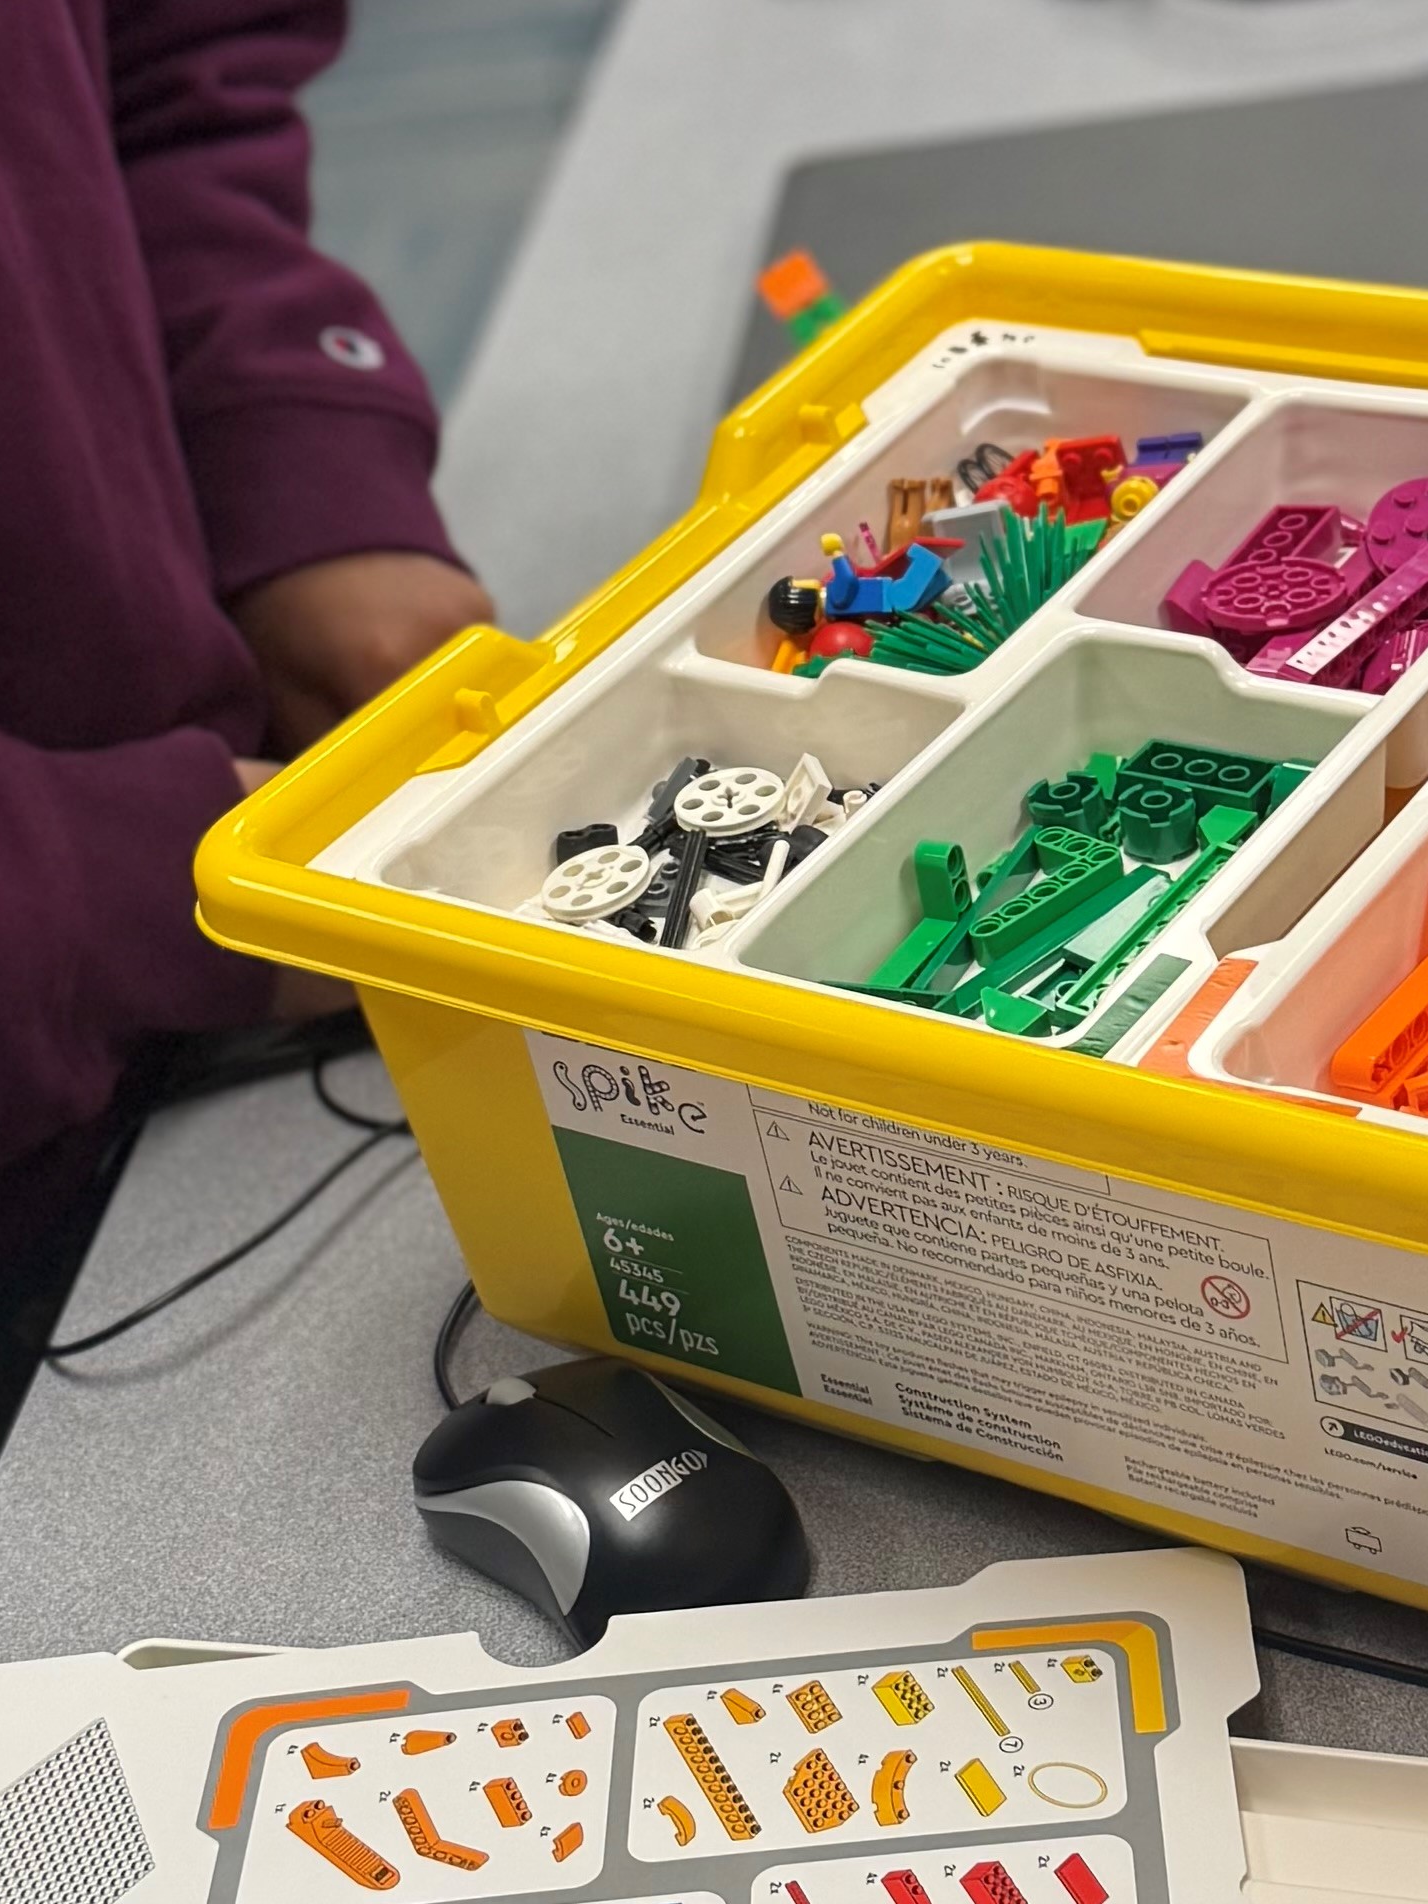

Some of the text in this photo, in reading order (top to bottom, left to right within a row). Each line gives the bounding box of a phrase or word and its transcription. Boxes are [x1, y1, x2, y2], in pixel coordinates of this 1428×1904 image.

[619, 1113, 674, 1135] Essential
[807, 1101, 1027, 1167] Not for children under 3 years.
[808, 1130, 1224, 1252] AVERTISSEMENT RISQUE D'ÉTOUFFEMENT.
[810, 1150, 1269, 1279] Le jouet contient des petites pièces ainsi qu'une petite boule.
[814, 1165, 1169, 1269] Il ne convient pas aux enfants de moins de 3 ans.
[595, 1211, 674, 1241] Ages/edades
[603, 1227, 644, 1255] 6+
[821, 1185, 1162, 1290] ADVERTENCIA: PELIGRO DE ASFIXIA.
[609, 1256, 663, 1282] 45345
[825, 1205, 1204, 1316] Juguete que contiene partes pequeñas y una pelota
[827, 1220, 1260, 1347] pequeña. No recomendado para niños menores de 3 años.
[618, 1278, 680, 1316] 449
[625, 1312, 719, 1355] pcs/pzs
[820, 1373, 869, 1394] Essential
[894, 1382, 1031, 1429] Construction System
[898, 1394, 1060, 1449] Système de construction
[901, 1405, 1063, 1461] Sistema de Construcción
[615, 1449, 704, 1516] SOONGO
[936, 1667, 949, 1678] 2x
[993, 1661, 1006, 1673] 2x
[1046, 1657, 1060, 1668] 4x
[772, 1683, 784, 1694] 4x
[857, 1674, 870, 1686] 2x
[706, 1690, 720, 1701] 4x
[649, 1716, 663, 1728] 2x
[769, 1751, 782, 1764] 2x
[858, 1753, 870, 1765] 4x
[939, 1760, 952, 1773] 2x
[1012, 1764, 1026, 1778] 2x
[642, 1797, 656, 1810] 2x
[943, 1864, 957, 1878] 2x
[1037, 1855, 1051, 1869] 2x
[769, 1881, 783, 1895] 2x
[865, 1872, 878, 1885] 4x
